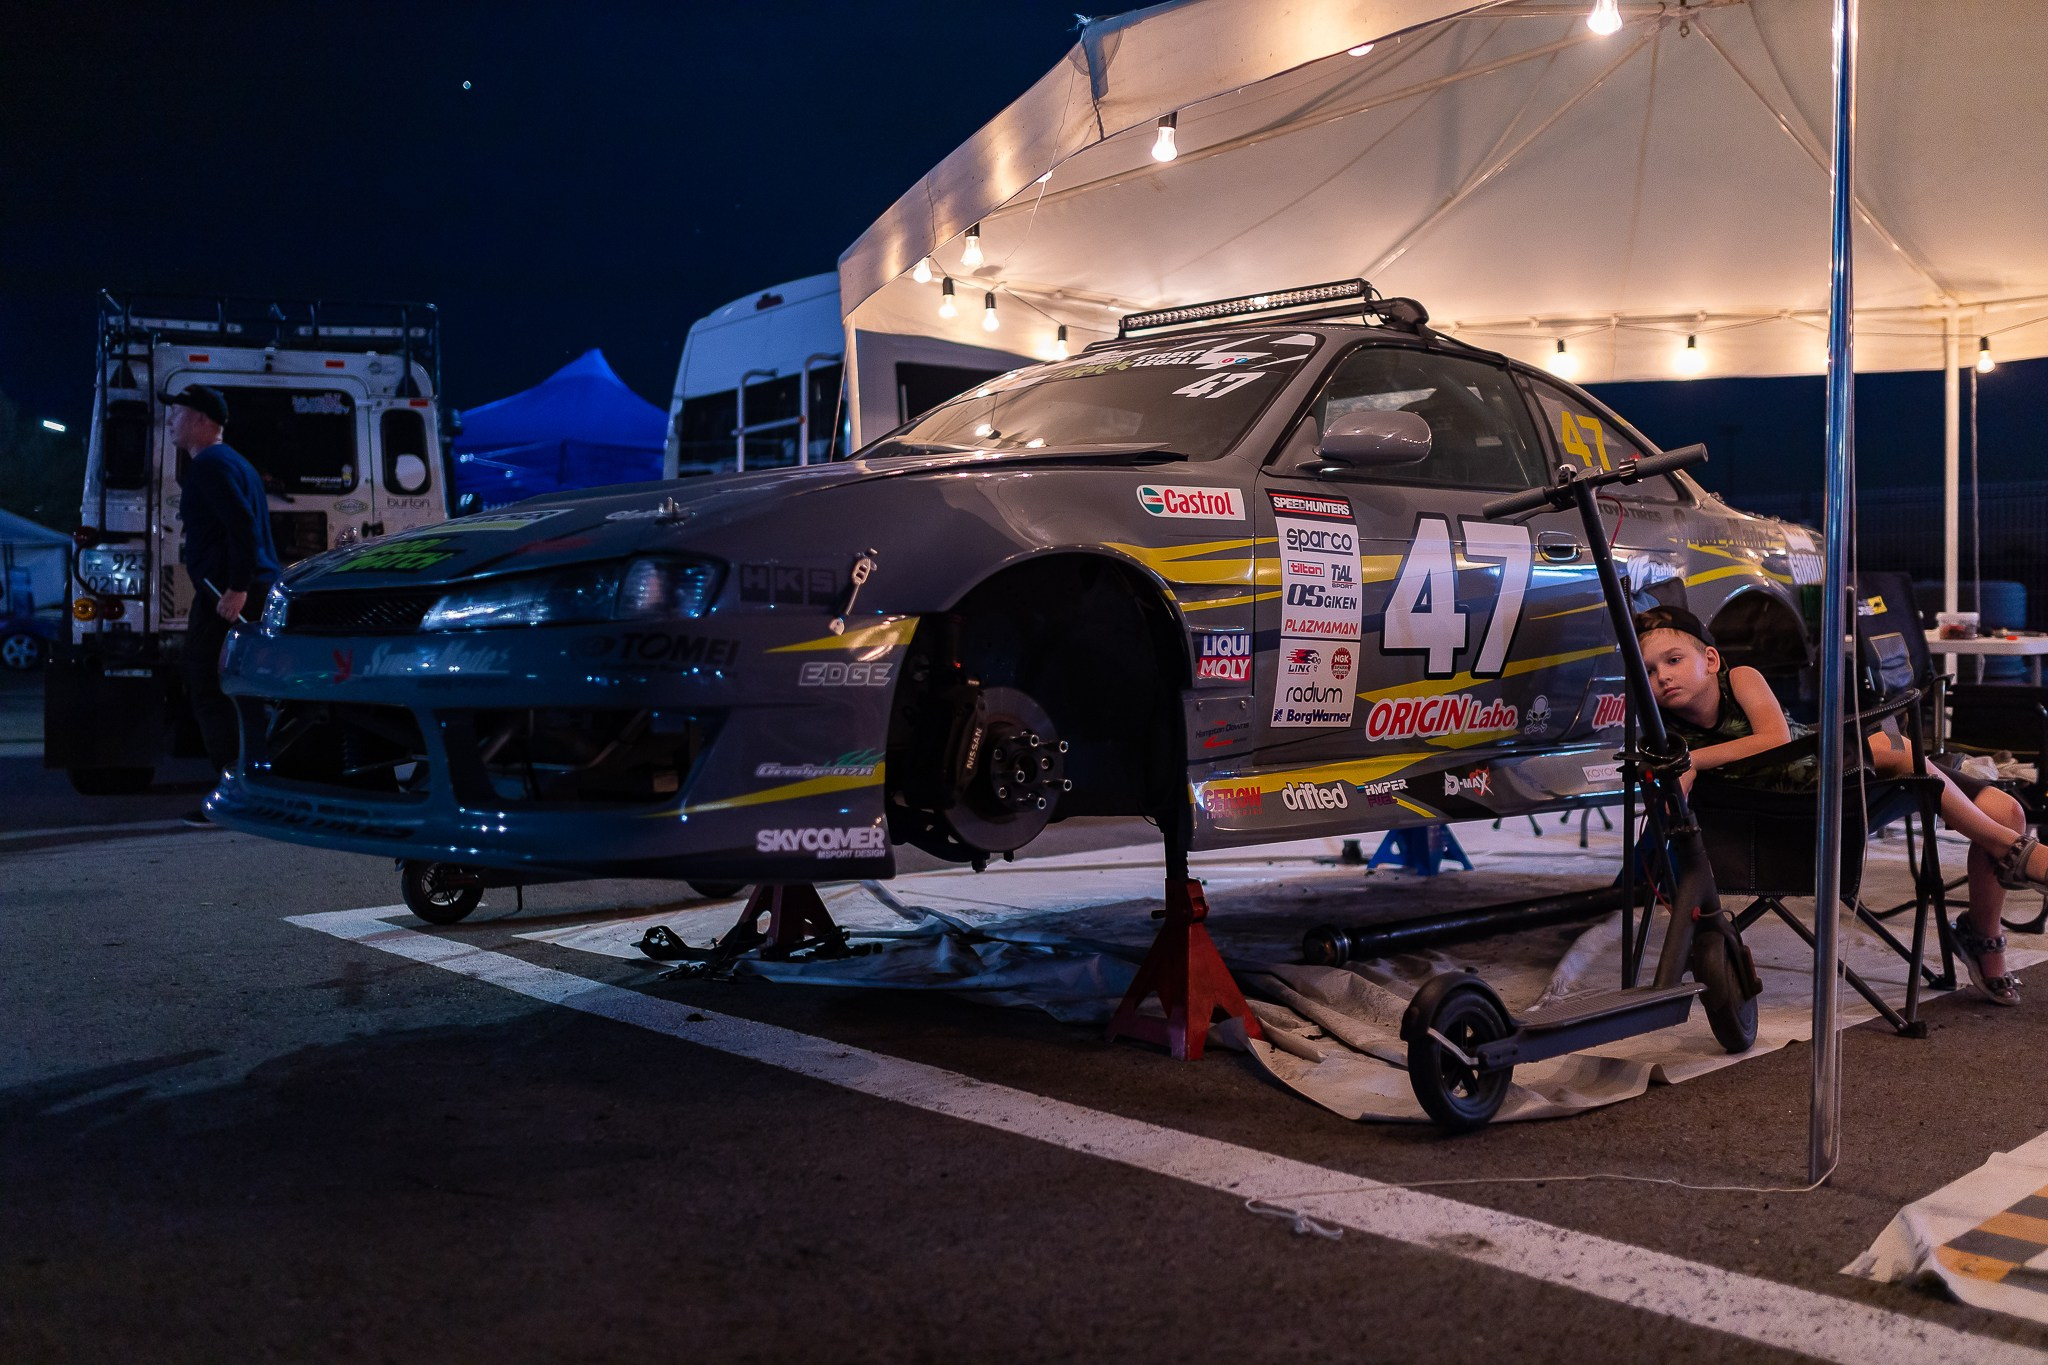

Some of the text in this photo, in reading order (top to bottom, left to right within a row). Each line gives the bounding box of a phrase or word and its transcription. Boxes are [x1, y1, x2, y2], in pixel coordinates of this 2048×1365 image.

[1131, 357, 1192, 367] LEGAL
[1133, 350, 1206, 361] STREET
[1172, 372, 1266, 399] 47
[1562, 411, 1611, 471] 47
[387, 497, 430, 509] burton
[1164, 489, 1235, 515] Castrol
[1273, 496, 1350, 515] SPEEDHUNTERS
[1286, 528, 1353, 553] sparco
[1291, 562, 1323, 575] tilton
[88, 576, 110, 594] 02
[741, 565, 835, 600] HKS
[1287, 583, 1358, 610] OS GIKEN
[1381, 514, 1532, 678] 47
[1284, 619, 1359, 635] PLAZMAMAN
[620, 631, 741, 667] TOMEI
[1203, 635, 1250, 657] LIQUI
[1200, 658, 1250, 679] MOLY
[1288, 664, 1312, 673] LINK
[1334, 654, 1349, 663] NGK
[799, 662, 893, 686] EDGE
[1286, 681, 1343, 703] radium
[1287, 709, 1351, 724] BorgWarner
[1368, 698, 1469, 737] ORIGIN
[1195, 722, 1249, 738] Hampton Downs
[966, 727, 982, 769] NISSAN
[1364, 779, 1408, 795] HYPER
[1444, 771, 1494, 796] D-MAX
[1203, 786, 1261, 811] GETLOW
[1282, 782, 1348, 810] drifted
[1366, 791, 1398, 807] FUEL
[757, 828, 885, 852] SKYCOMER
[855, 849, 885, 857] DESIGN
